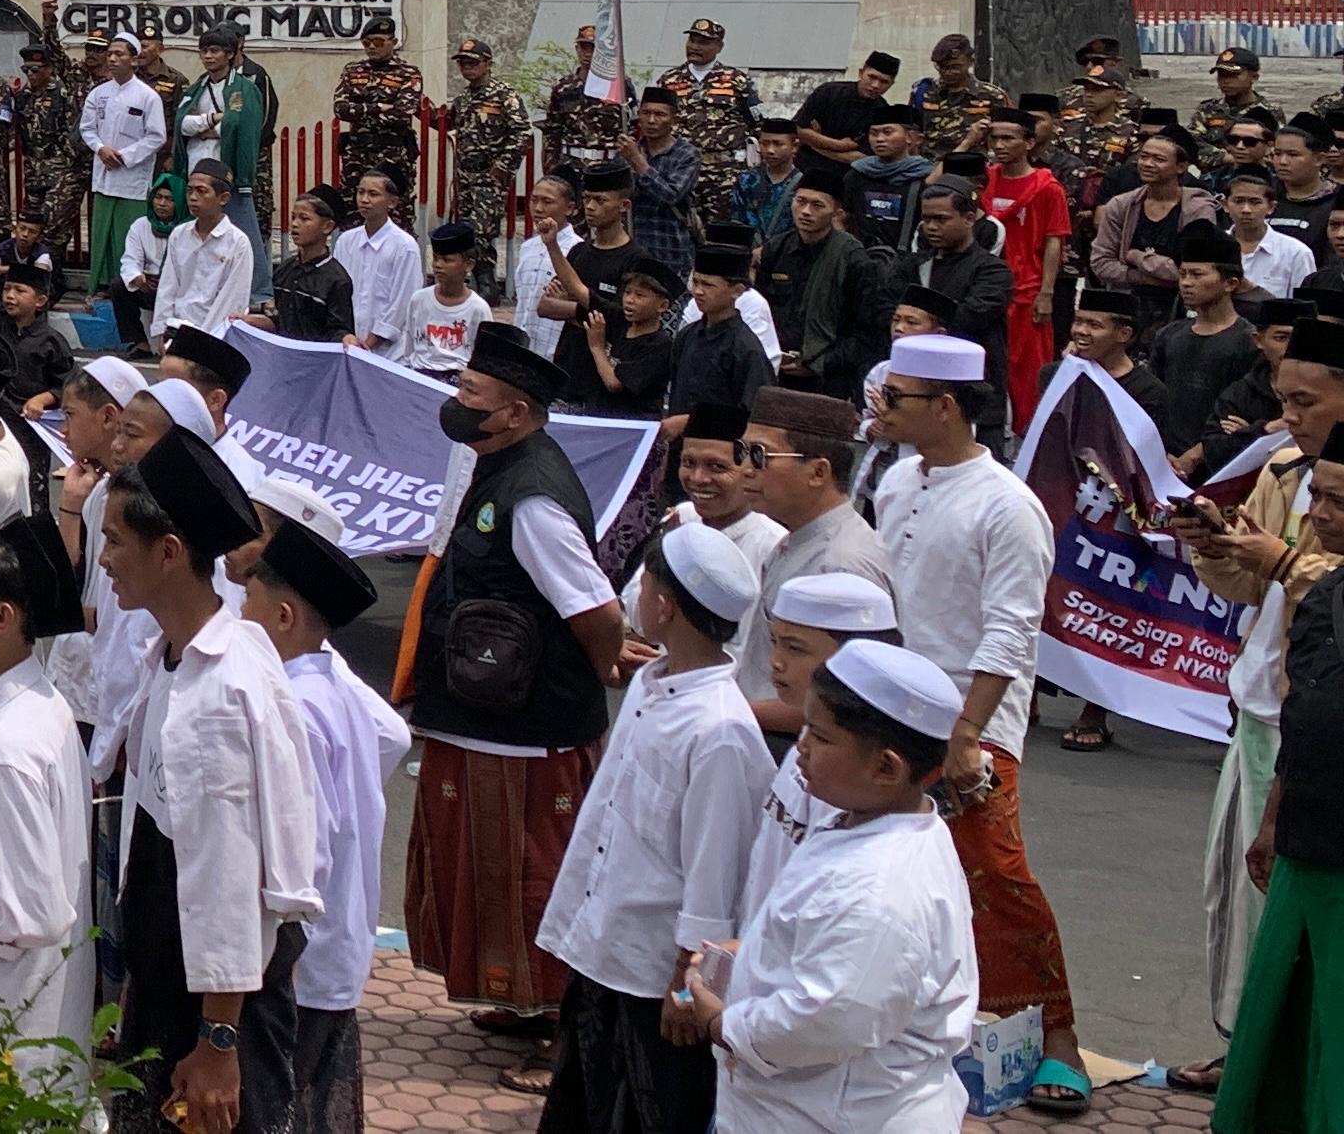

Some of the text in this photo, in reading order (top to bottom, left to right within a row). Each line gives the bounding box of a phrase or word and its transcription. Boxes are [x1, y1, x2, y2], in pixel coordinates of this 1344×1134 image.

[225, 413, 352, 481] NTREH
[1062, 613, 1145, 659] HARTA
[1063, 589, 1129, 629] Saya
[1132, 617, 1184, 649] Siap
